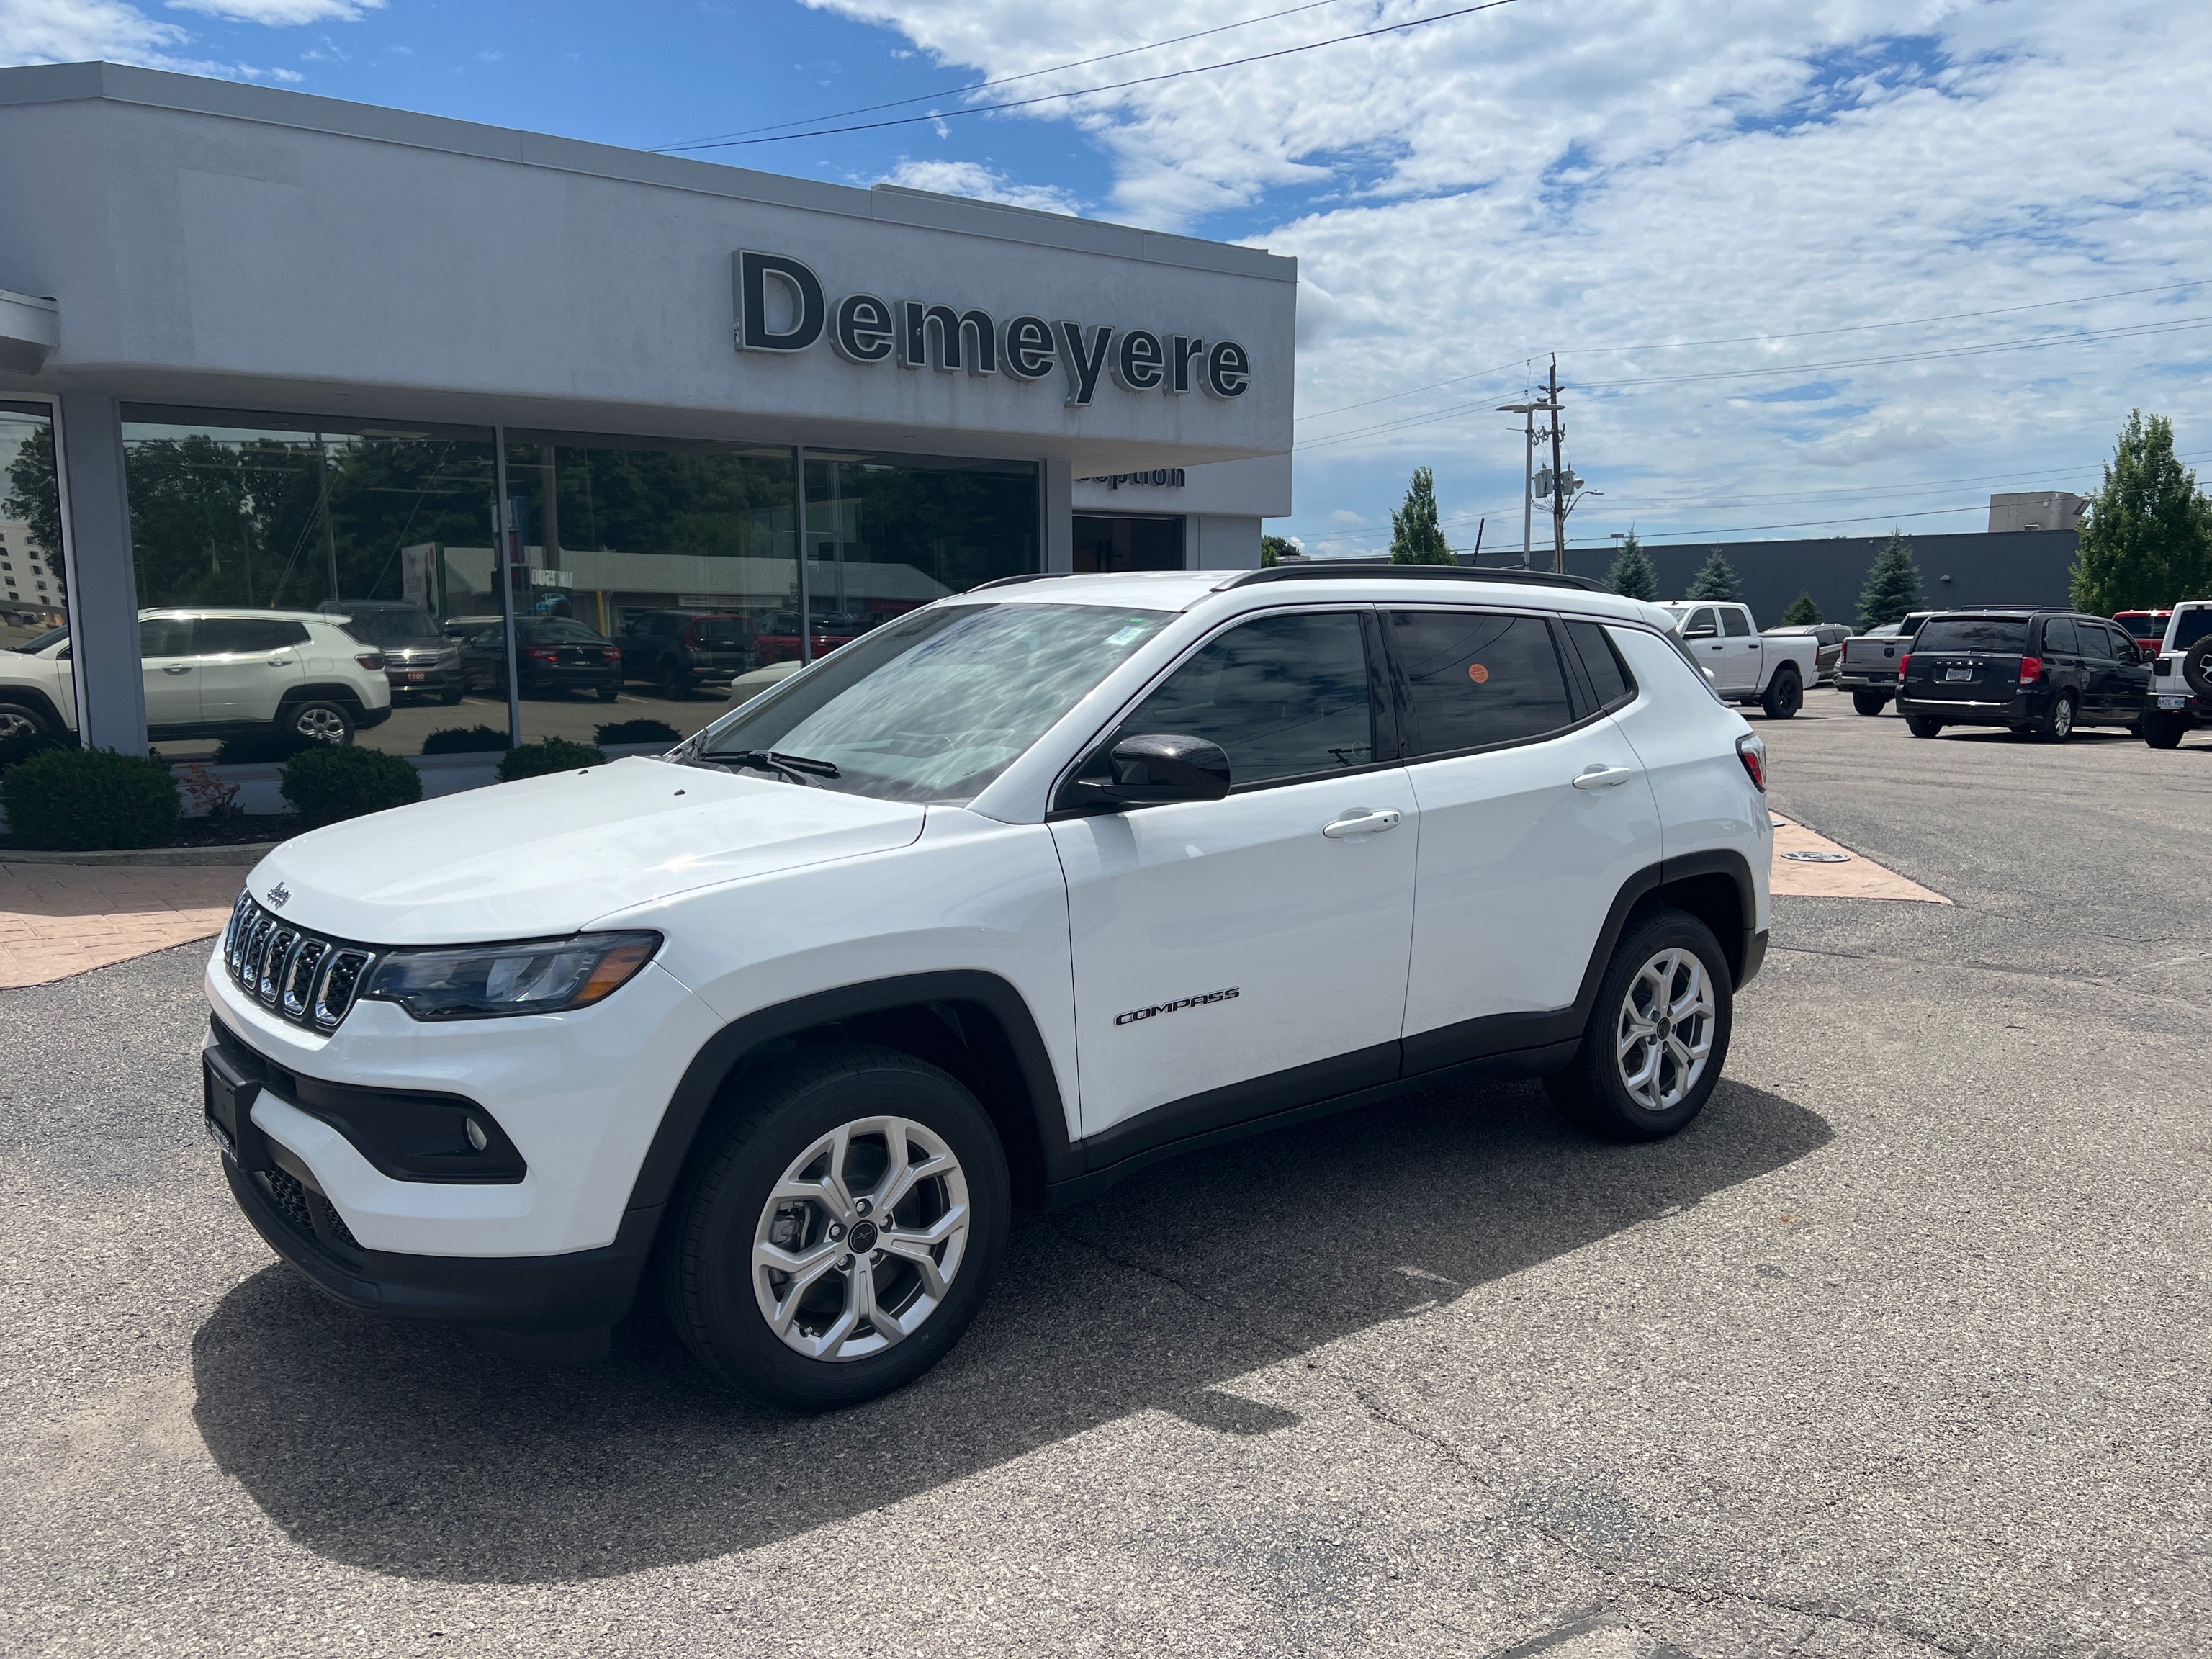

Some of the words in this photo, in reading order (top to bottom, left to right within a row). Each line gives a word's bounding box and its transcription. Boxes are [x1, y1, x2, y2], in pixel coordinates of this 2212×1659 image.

[732, 249, 1251, 407] Demeyere
[267, 881, 292, 911] Jeep
[1114, 986, 1240, 1027] COMPASS
